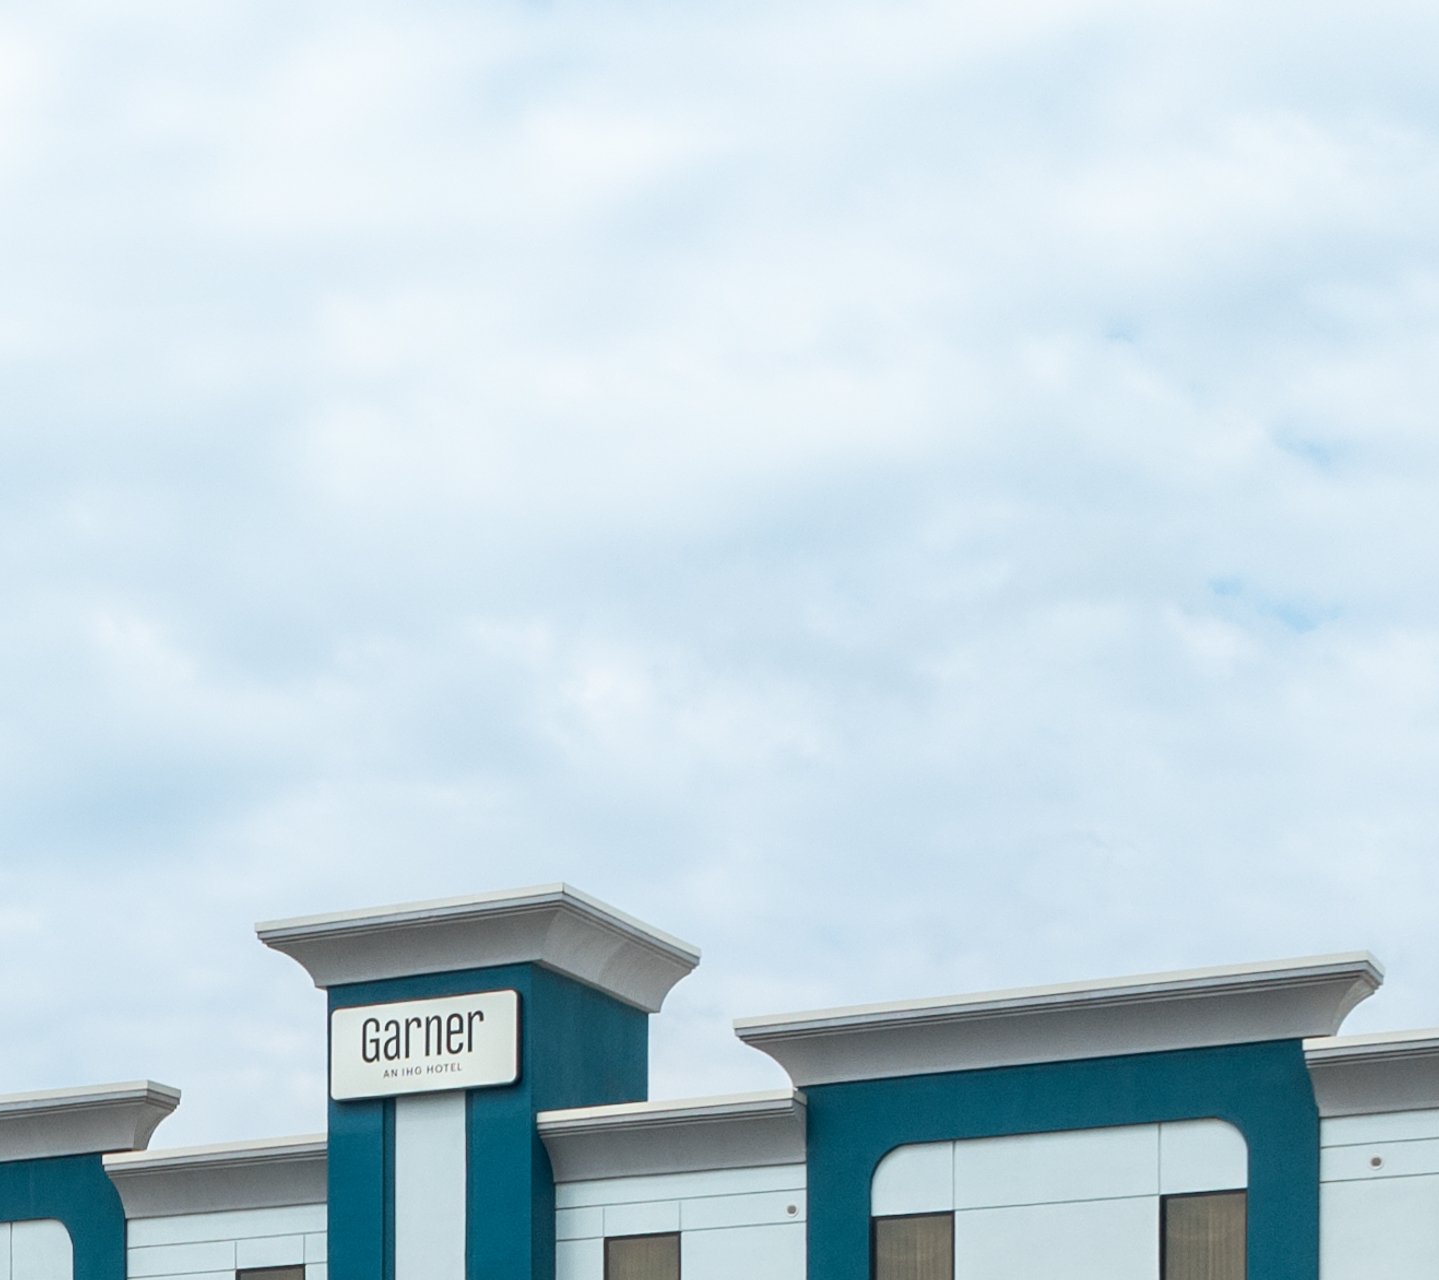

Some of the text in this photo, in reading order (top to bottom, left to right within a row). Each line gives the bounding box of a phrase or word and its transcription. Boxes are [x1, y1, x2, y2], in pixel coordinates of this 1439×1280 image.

[361, 1009, 485, 1064] Garner
[383, 1062, 463, 1079] AN IHG HOTEL
